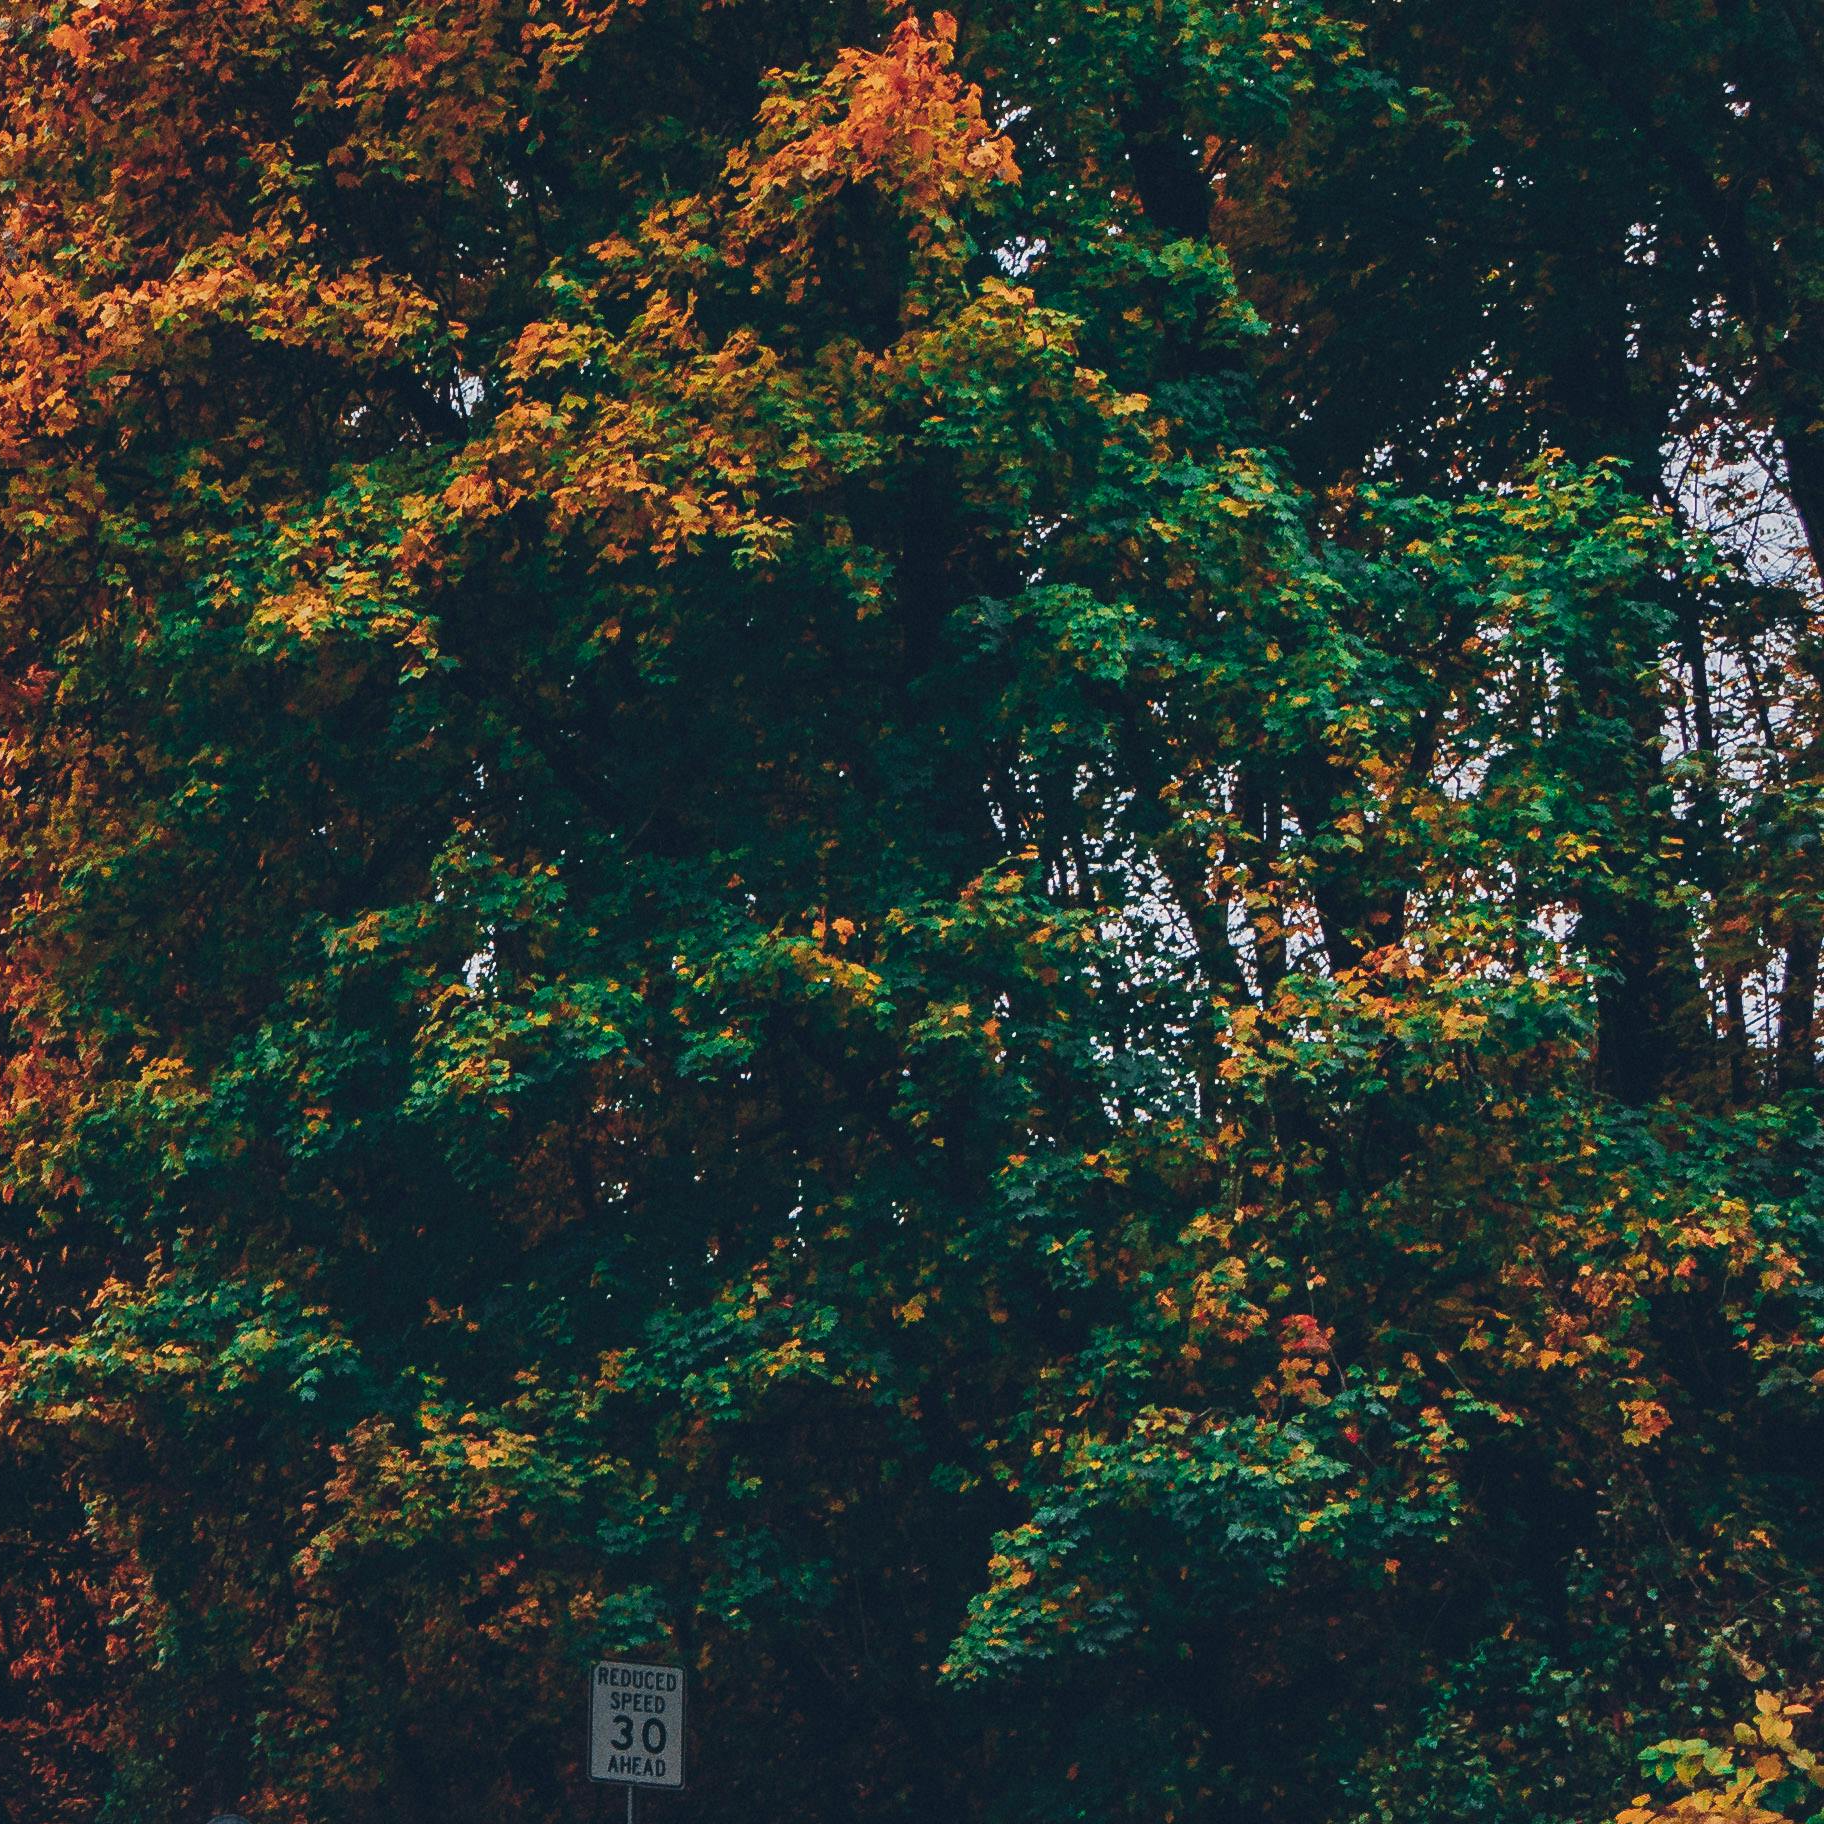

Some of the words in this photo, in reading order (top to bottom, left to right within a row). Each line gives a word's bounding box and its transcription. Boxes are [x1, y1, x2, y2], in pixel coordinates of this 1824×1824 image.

[597, 1667, 677, 1692] REDUCED
[610, 1691, 666, 1714] SPEED
[611, 1714, 667, 1754] 30
[607, 1755, 666, 1777] AHEAD
